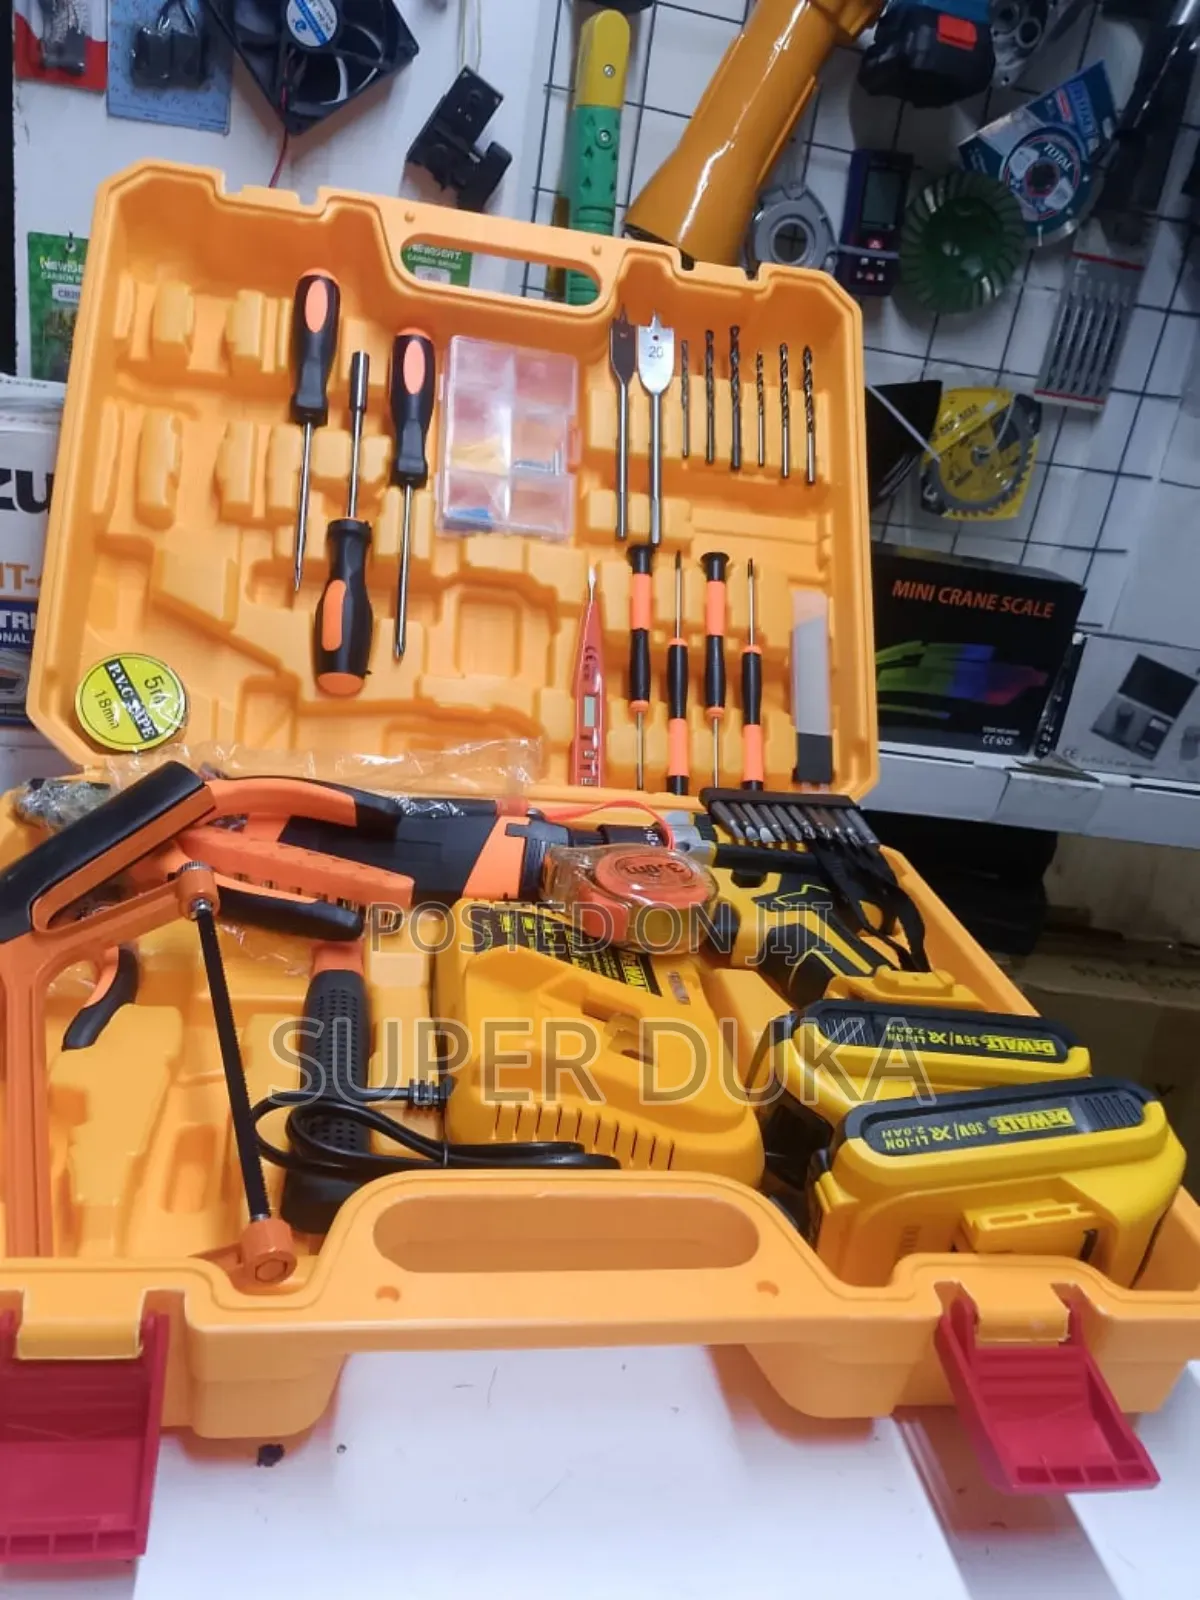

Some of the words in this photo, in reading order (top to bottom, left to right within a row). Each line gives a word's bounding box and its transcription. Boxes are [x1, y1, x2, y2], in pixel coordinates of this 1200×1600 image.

[1044, 143, 1073, 172] TOTAL
[647, 345, 664, 358] 20
[891, 579, 936, 602] MINI
[938, 587, 999, 612] CRANE
[1000, 596, 1056, 619] SCALE
[957, 1122, 988, 1138] 36V
[884, 1133, 930, 1151] LI-ION
